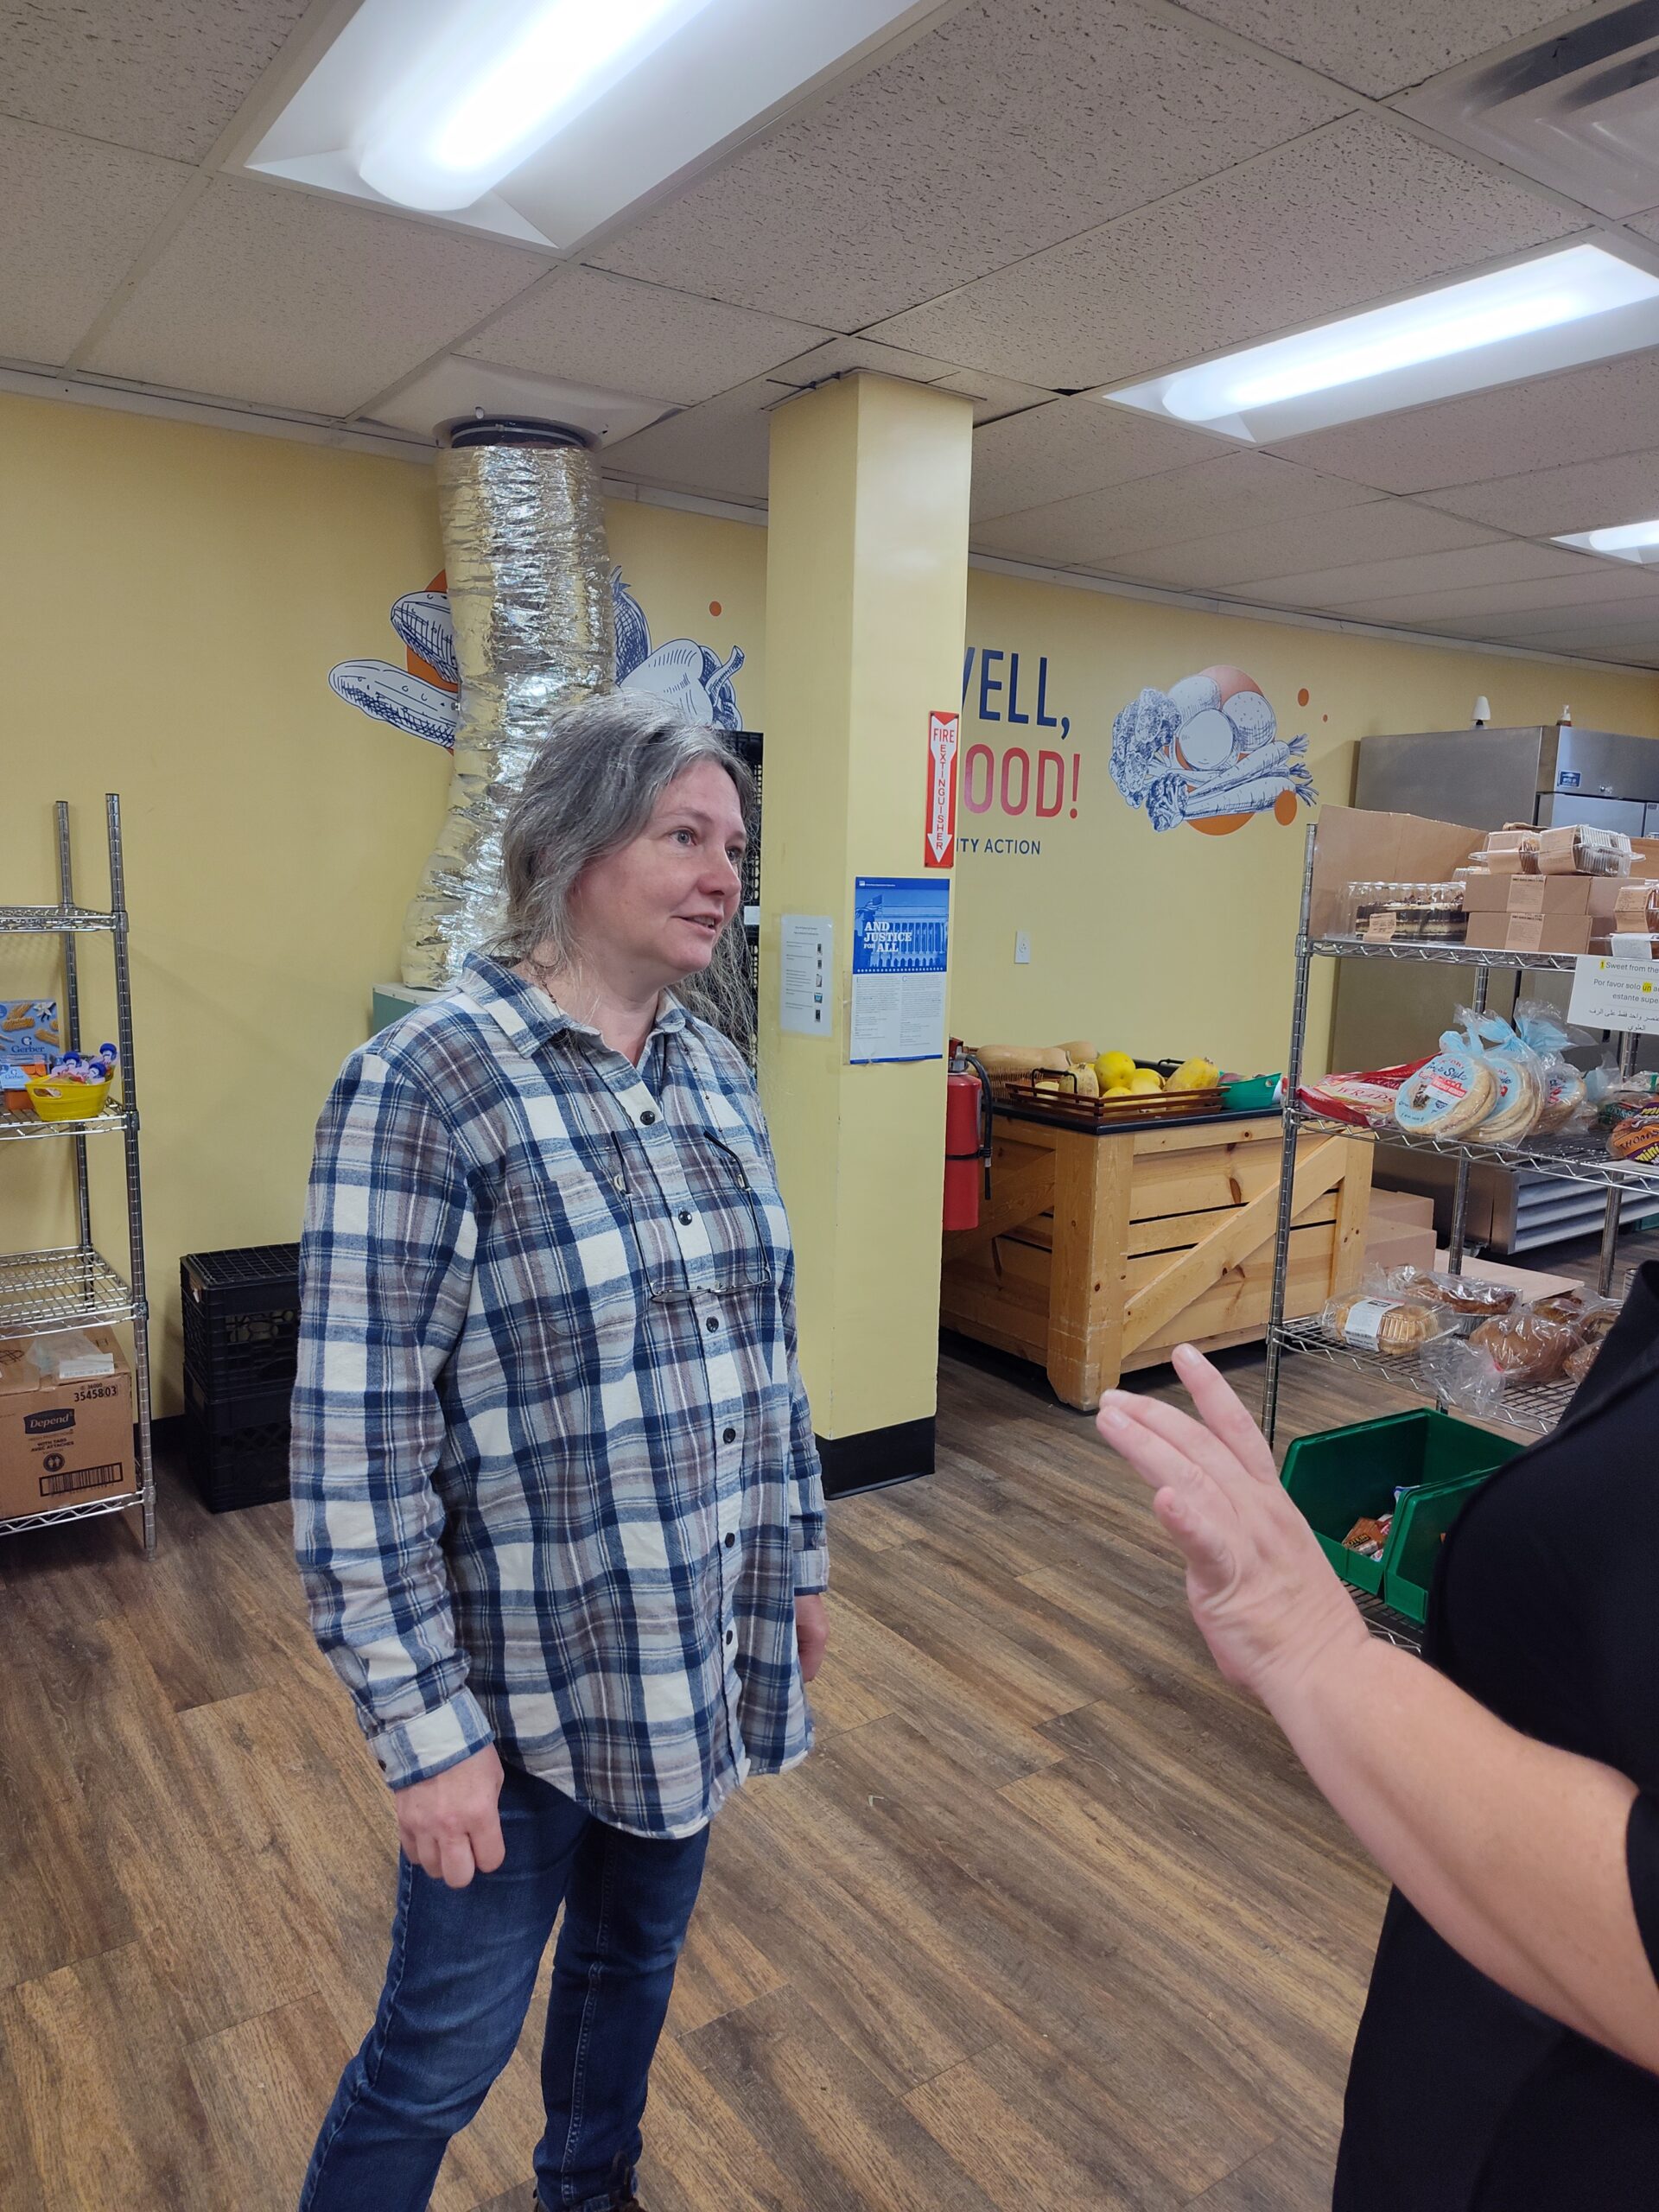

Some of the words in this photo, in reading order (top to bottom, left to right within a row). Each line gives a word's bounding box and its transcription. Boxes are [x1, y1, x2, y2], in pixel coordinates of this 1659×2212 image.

[933, 728, 955, 743] FIRE
[936, 744, 947, 850] EXTINGUISHER
[983, 838, 1041, 855] ACTION
[864, 921, 890, 931] AND
[864, 931, 912, 942] JUSTICE
[877, 943, 899, 952] ALL
[1630, 963, 1646, 972] from
[1607, 980, 1624, 988] favor
[1612, 993, 1639, 1002] estante
[11, 1045, 46, 1053] Gerber
[73, 1385, 118, 1402] 3545803
[29, 1413, 70, 1429] Depend
